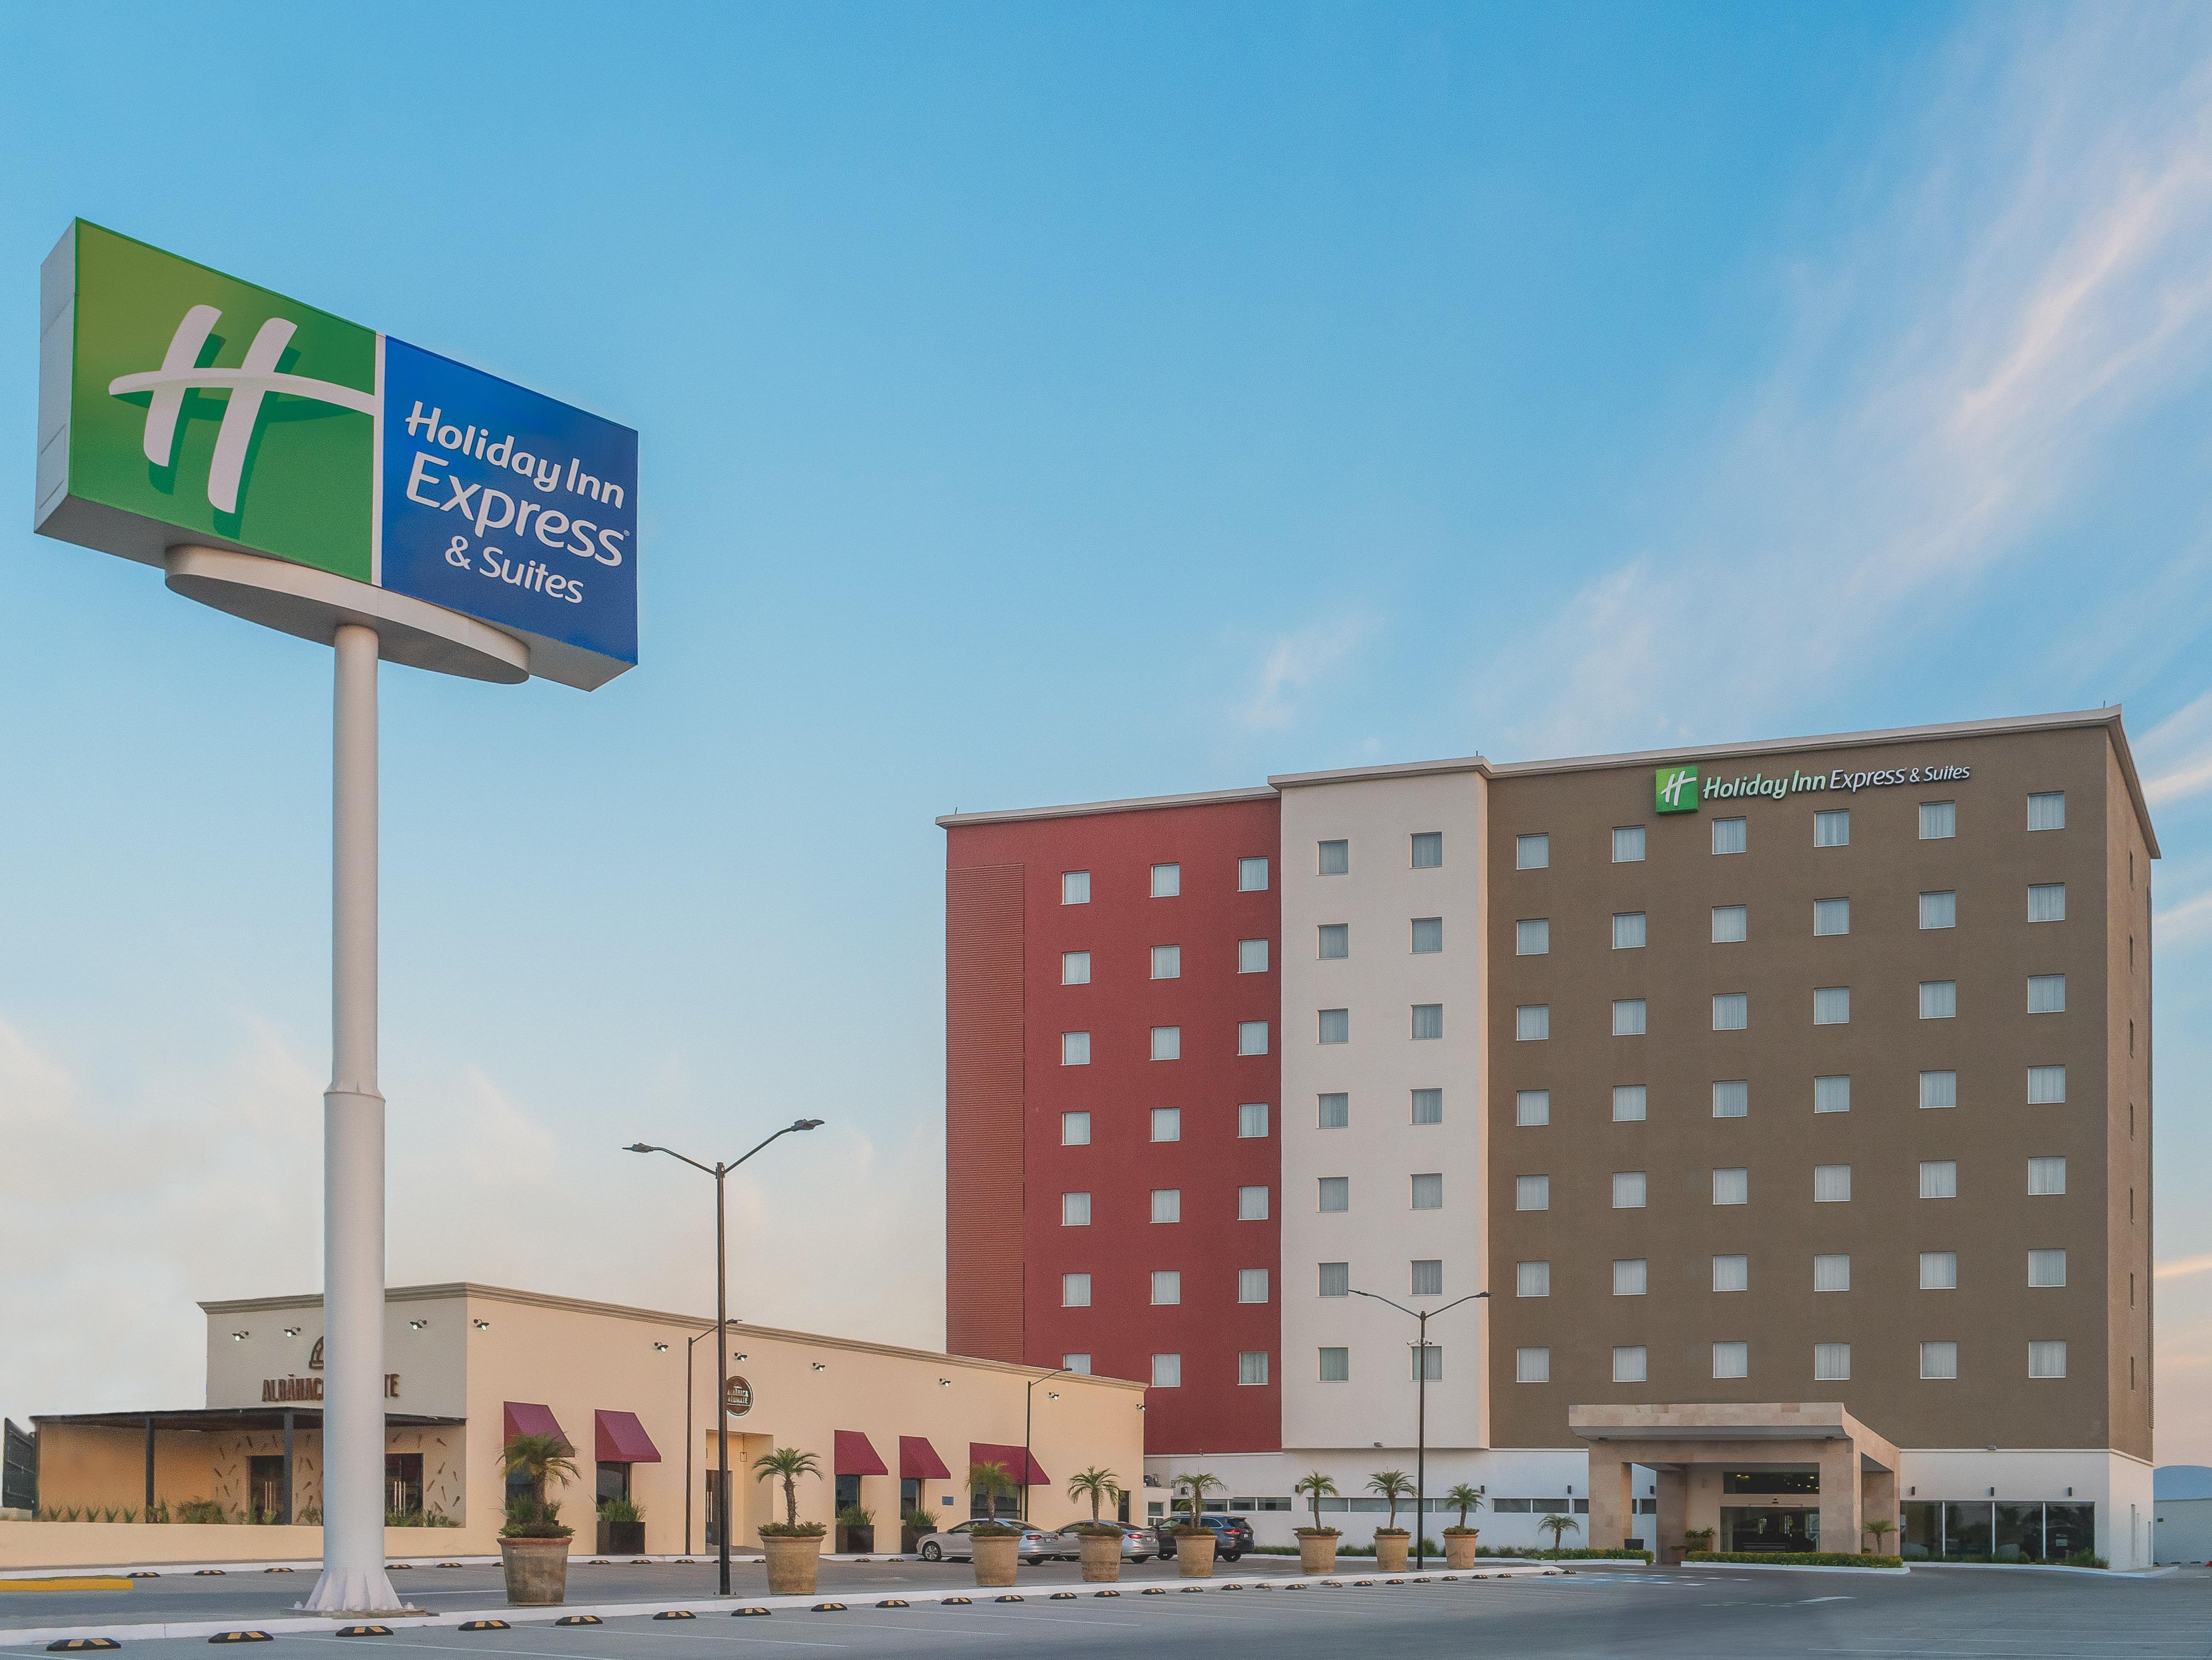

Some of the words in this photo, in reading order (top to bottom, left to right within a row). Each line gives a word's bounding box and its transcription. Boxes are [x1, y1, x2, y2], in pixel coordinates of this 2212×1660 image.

[405, 400, 561, 492] Holiday
[566, 457, 625, 509] Inn
[445, 535, 472, 570] &
[479, 546, 584, 604] Suites
[1703, 773, 1788, 799] Holiday
[1791, 769, 1826, 792] Inn
[1909, 767, 1921, 783] &
[1923, 765, 1970, 782] Suites
